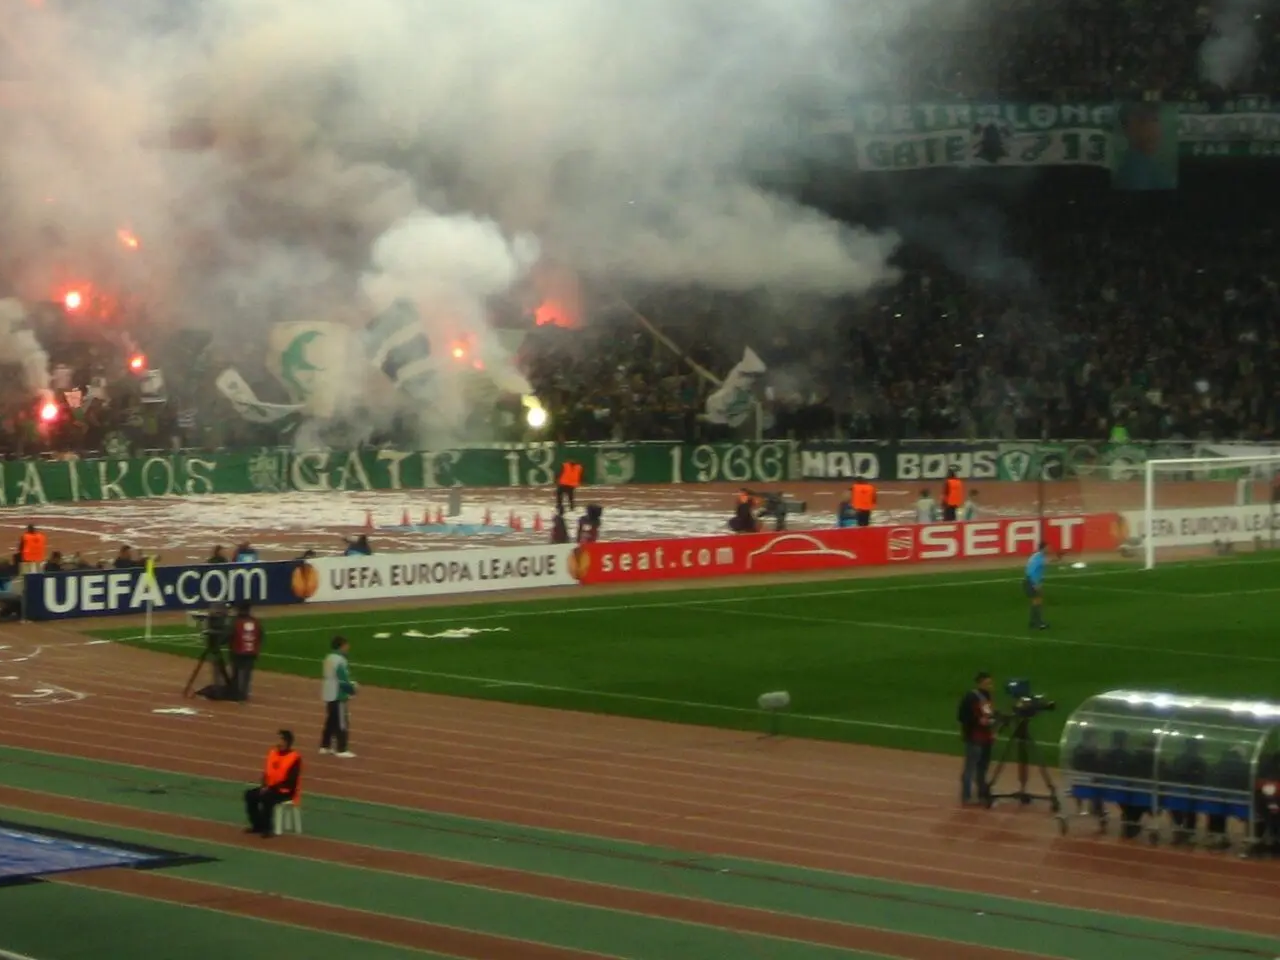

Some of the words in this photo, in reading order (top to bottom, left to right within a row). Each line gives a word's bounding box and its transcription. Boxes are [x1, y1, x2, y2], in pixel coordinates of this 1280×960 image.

[866, 135, 965, 167] GATE
[289, 446, 464, 491] GATE
[505, 442, 557, 487] 13
[670, 444, 785, 483] 1966
[801, 450, 879, 480] MAD
[896, 450, 998, 480] BOYS
[919, 517, 1084, 558] SEAT
[330, 564, 382, 590] UEFA
[389, 558, 472, 587] EUROPA
[478, 554, 558, 580] LEAGUE
[601, 547, 734, 572] seat.com
